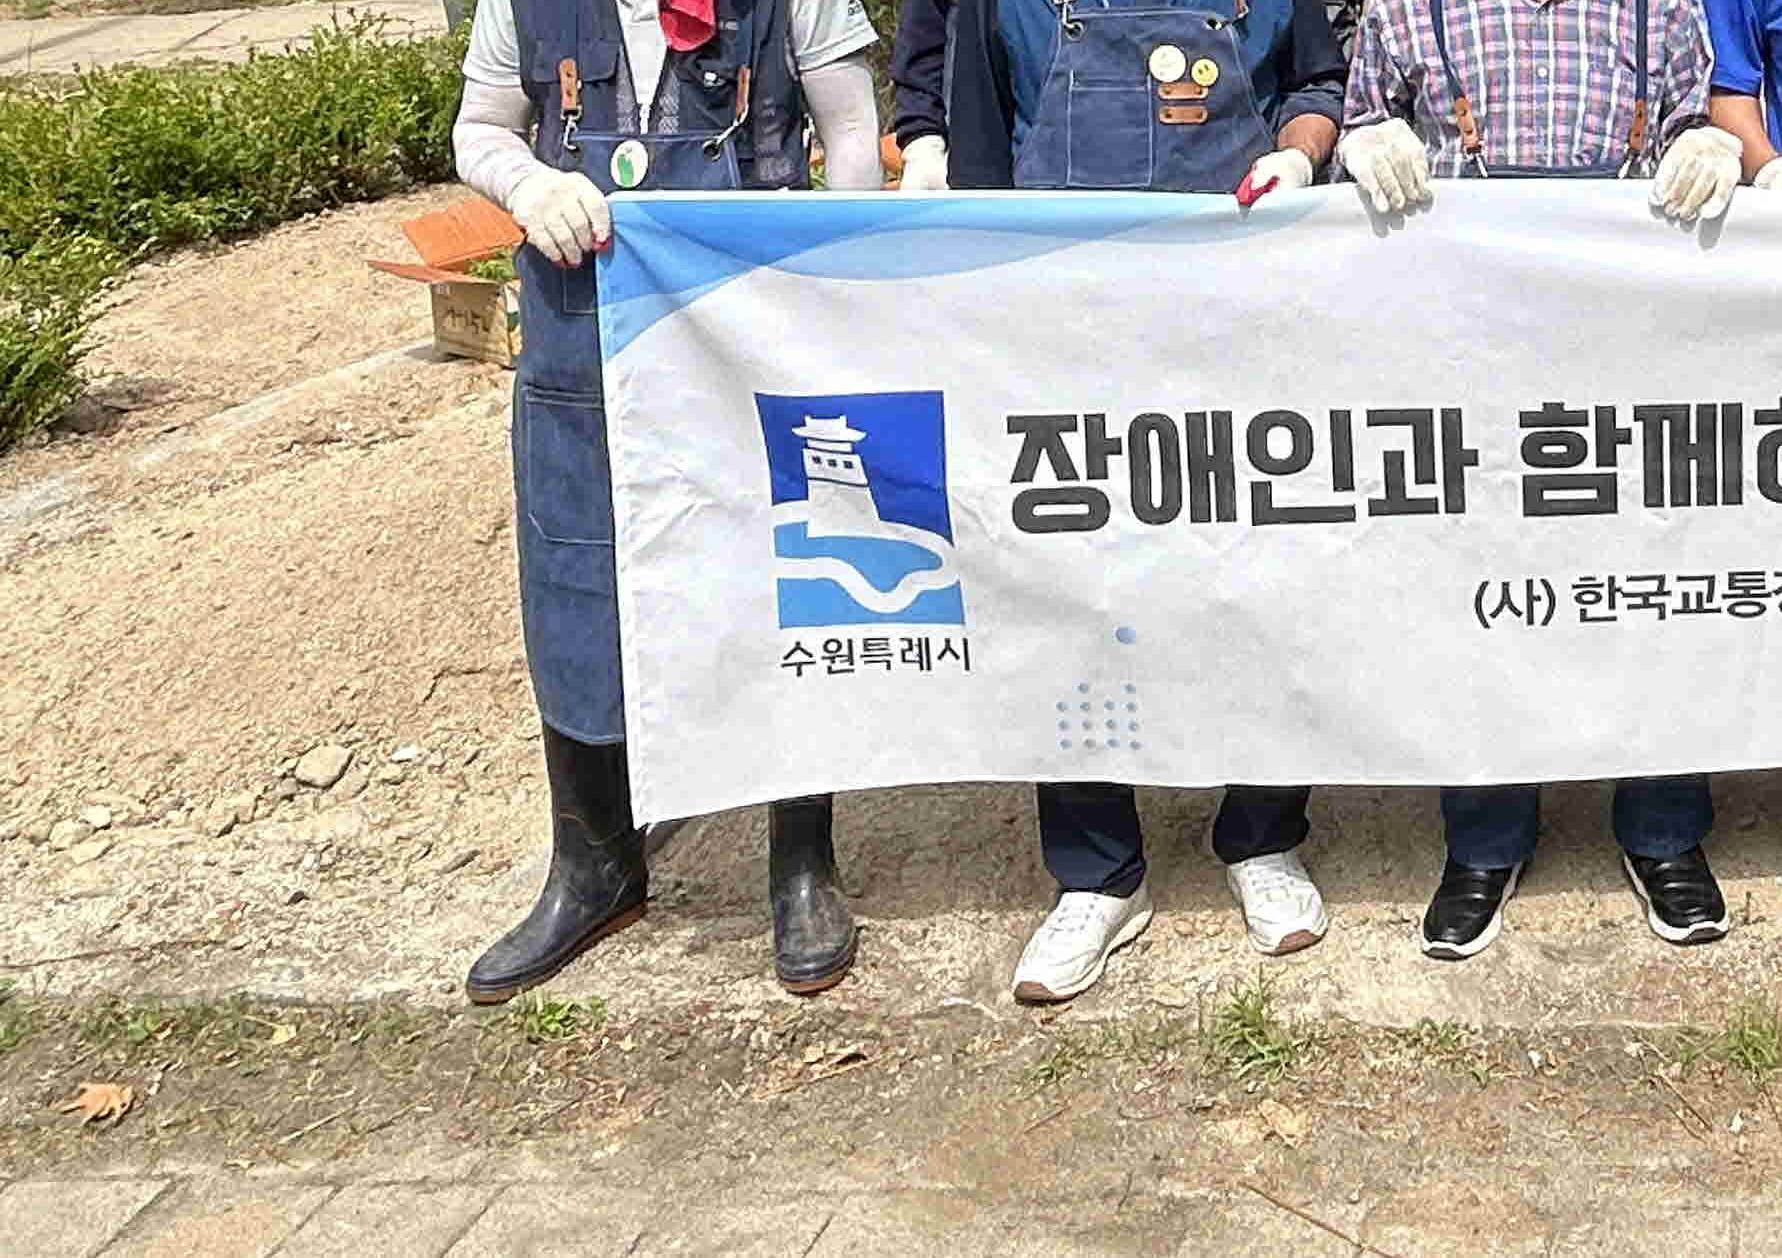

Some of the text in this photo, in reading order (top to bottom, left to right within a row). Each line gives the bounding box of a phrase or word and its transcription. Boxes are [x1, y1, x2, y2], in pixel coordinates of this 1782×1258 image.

[1006, 407, 1479, 534] 장애인과
[1473, 577, 1557, 629] (사)
[779, 636, 973, 678] 수원특례시
